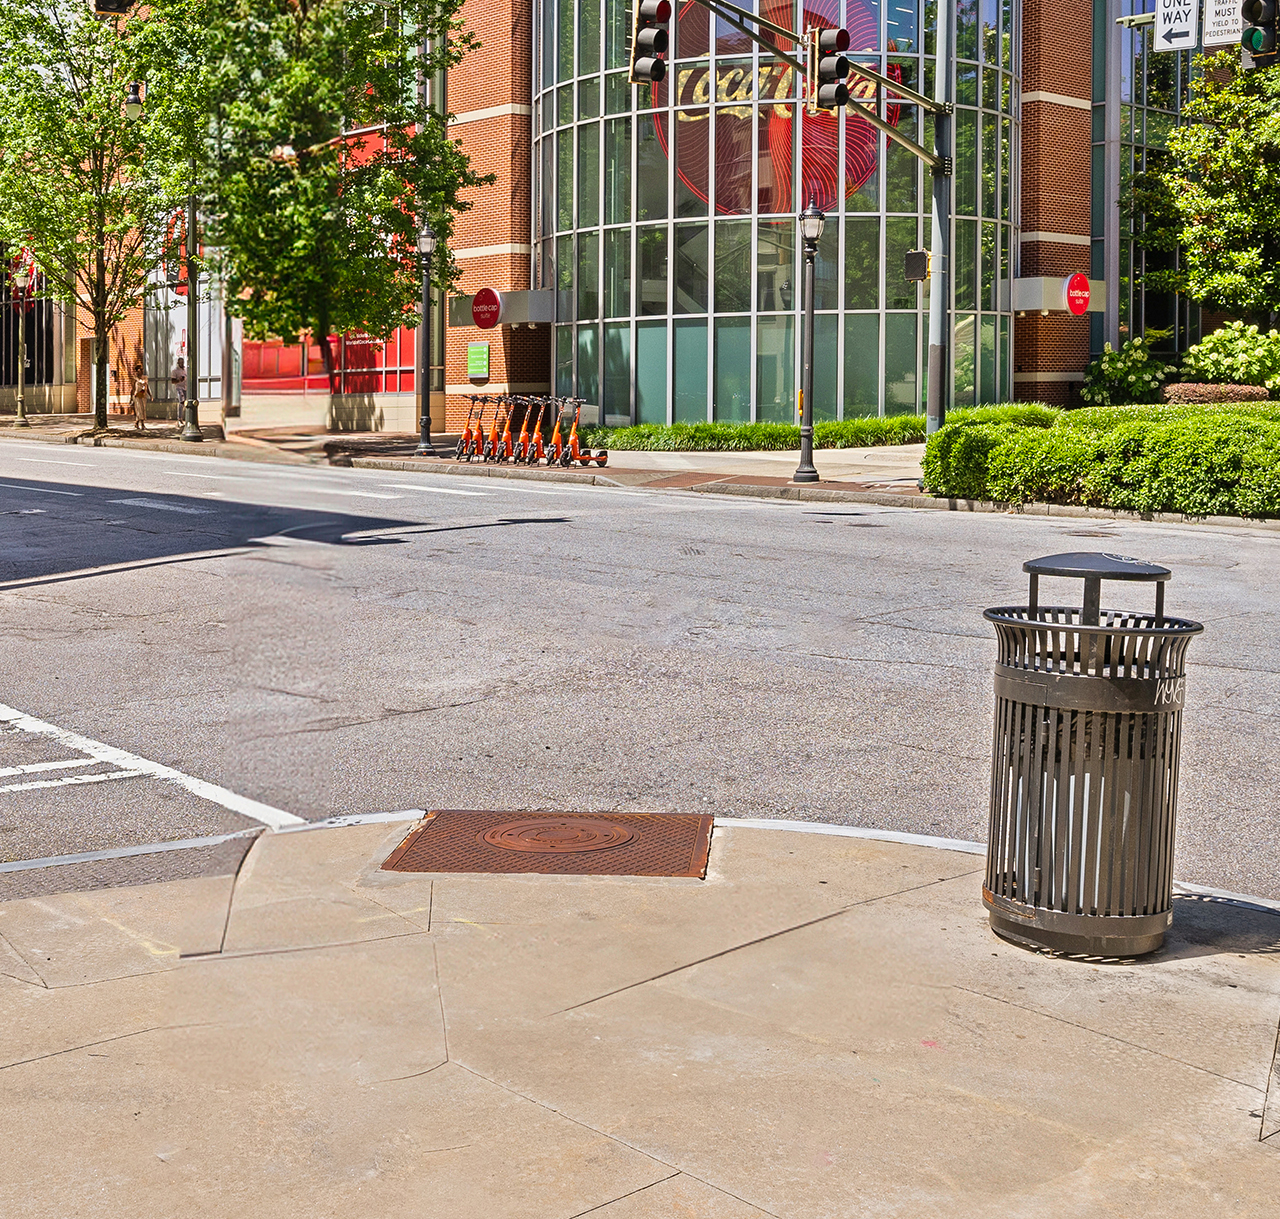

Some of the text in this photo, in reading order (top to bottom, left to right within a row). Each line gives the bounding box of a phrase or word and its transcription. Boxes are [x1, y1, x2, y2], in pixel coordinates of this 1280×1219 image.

[1214, 7, 1237, 18] MUST
[1162, 9, 1192, 25] WAY
[1211, 20, 1229, 28] YIELD
[1070, 289, 1081, 297] bottle
[473, 304, 497, 312] bottle cap
